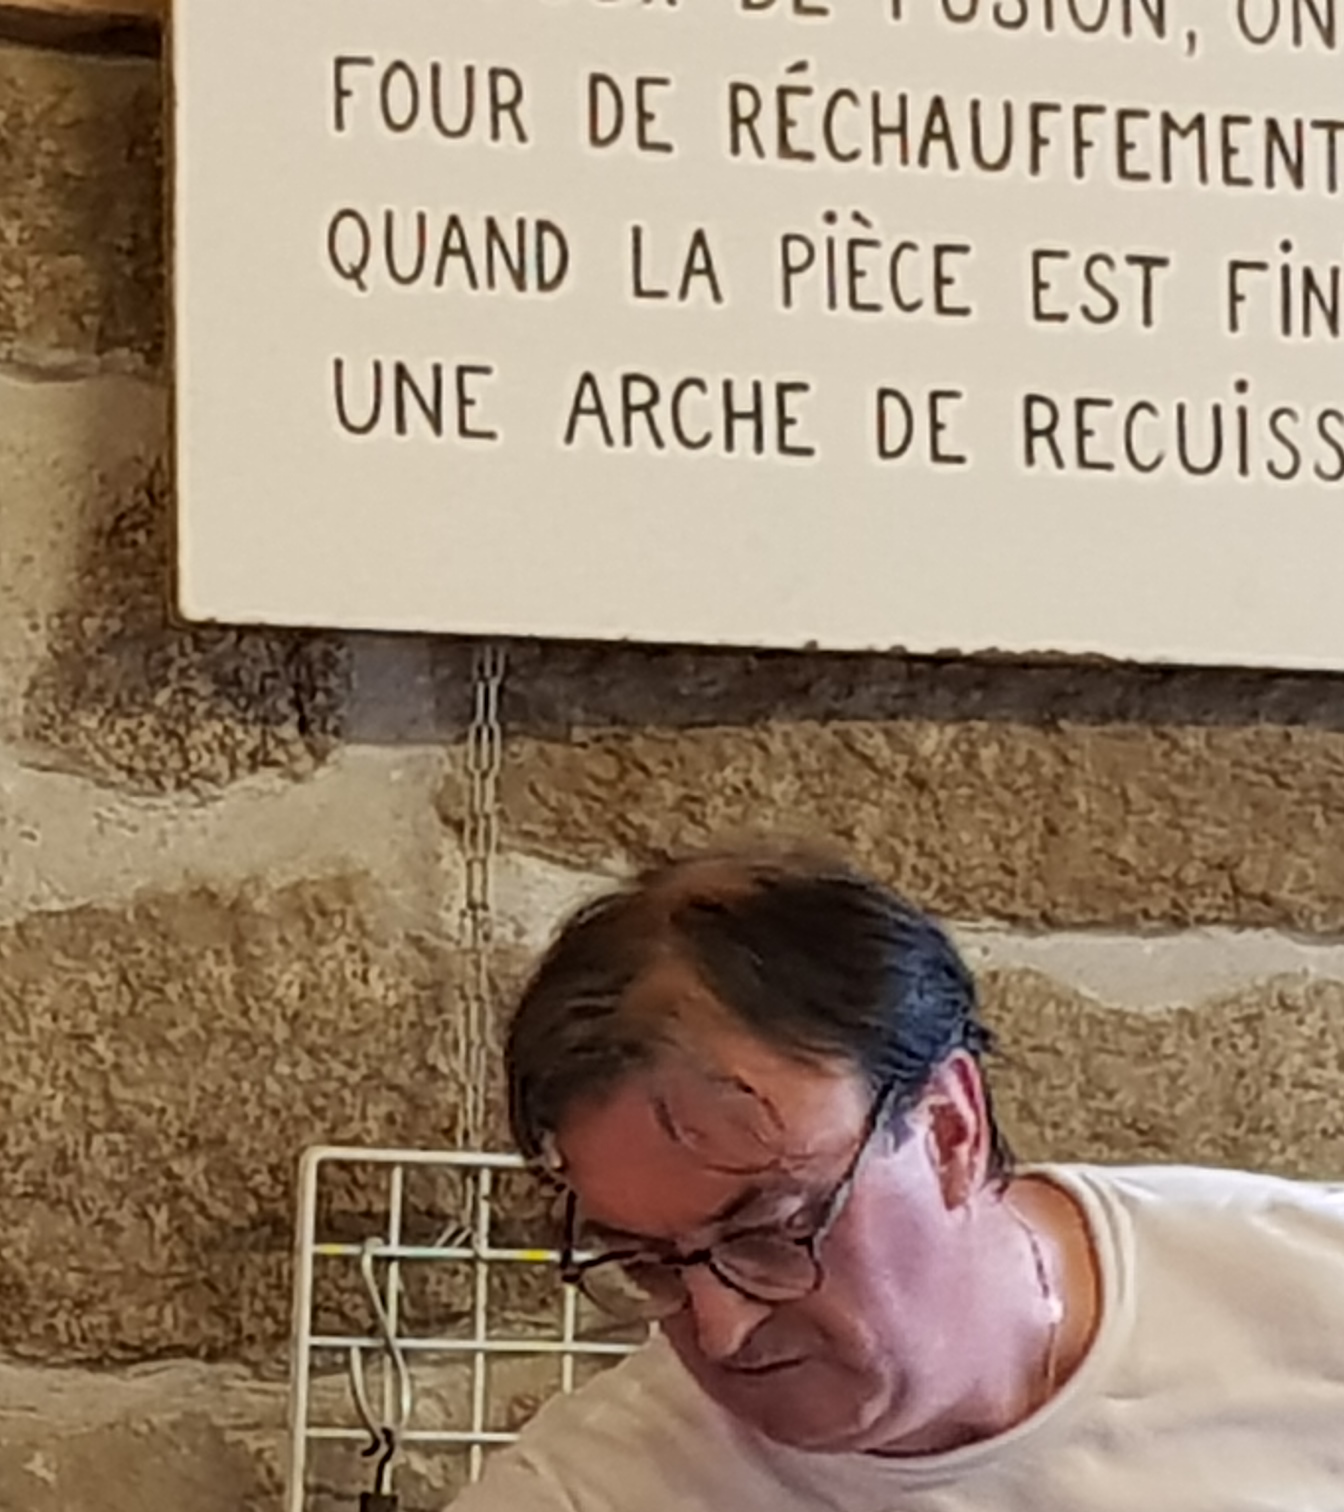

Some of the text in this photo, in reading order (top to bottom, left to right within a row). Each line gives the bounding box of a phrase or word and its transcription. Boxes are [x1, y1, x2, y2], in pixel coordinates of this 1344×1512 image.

[332, 54, 530, 145] FOUR
[587, 70, 675, 155] DE
[326, 206, 571, 294] QUAND
[630, 223, 725, 305] LA
[1030, 247, 1171, 329] EST
[332, 356, 499, 442] UNE
[562, 369, 817, 459] ARCHE
[875, 385, 968, 466] DE
